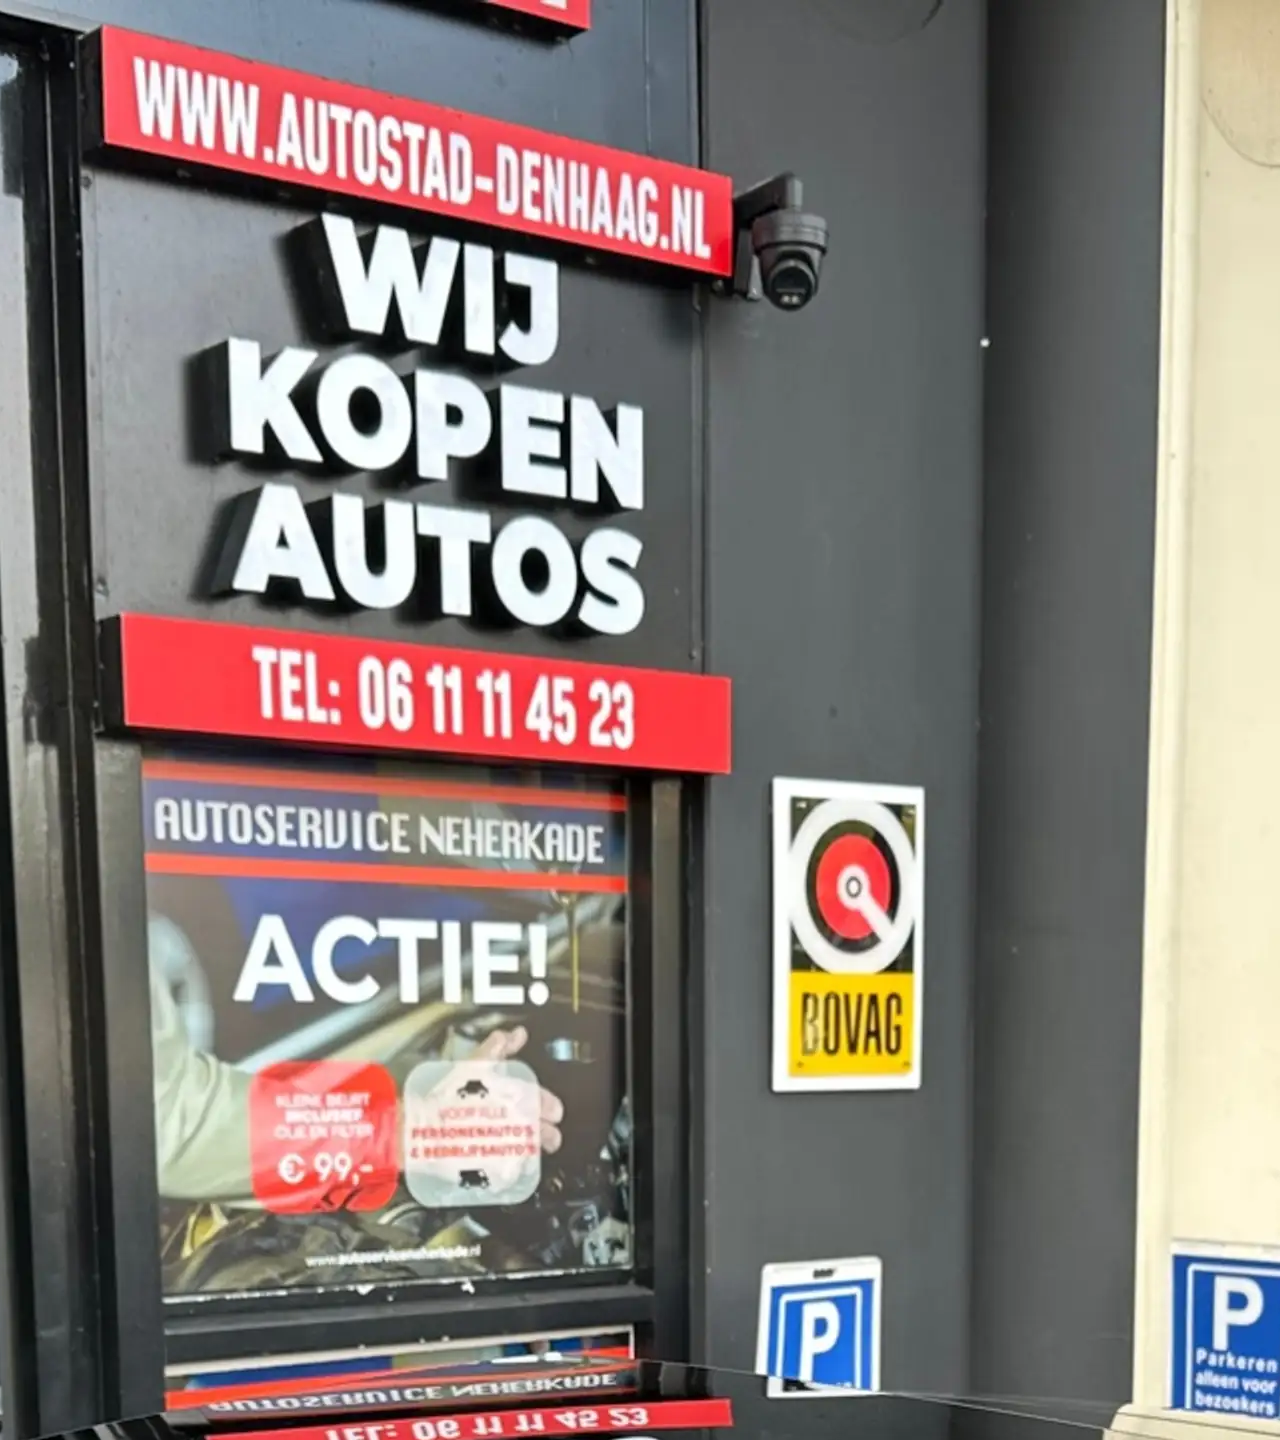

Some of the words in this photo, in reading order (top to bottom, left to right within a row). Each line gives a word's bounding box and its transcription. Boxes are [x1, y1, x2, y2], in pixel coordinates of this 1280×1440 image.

[133, 56, 713, 260] WWW.AUTOSTAD-DENHAAG.NL
[322, 211, 559, 366] WIJ
[227, 337, 645, 511] KOPEN
[232, 482, 646, 635] AUTOS
[252, 646, 341, 725] TEL:
[357, 656, 414, 732] 06
[426, 665, 464, 734] 11
[476, 670, 513, 739] 11
[525, 675, 578, 746] 45
[588, 680, 635, 750] 23
[155, 797, 410, 855] AUTOSERVICE
[419, 815, 604, 864] NEHERKADE
[232, 913, 550, 1006] ACTIE!
[801, 992, 904, 1057] BOVAG
[1212, 1274, 1264, 1351] P
[1195, 1346, 1278, 1373] Parkeren
[1195, 1369, 1239, 1390] alleen
[1241, 1377, 1277, 1395] voor
[1194, 1390, 1275, 1417] bezoekers
